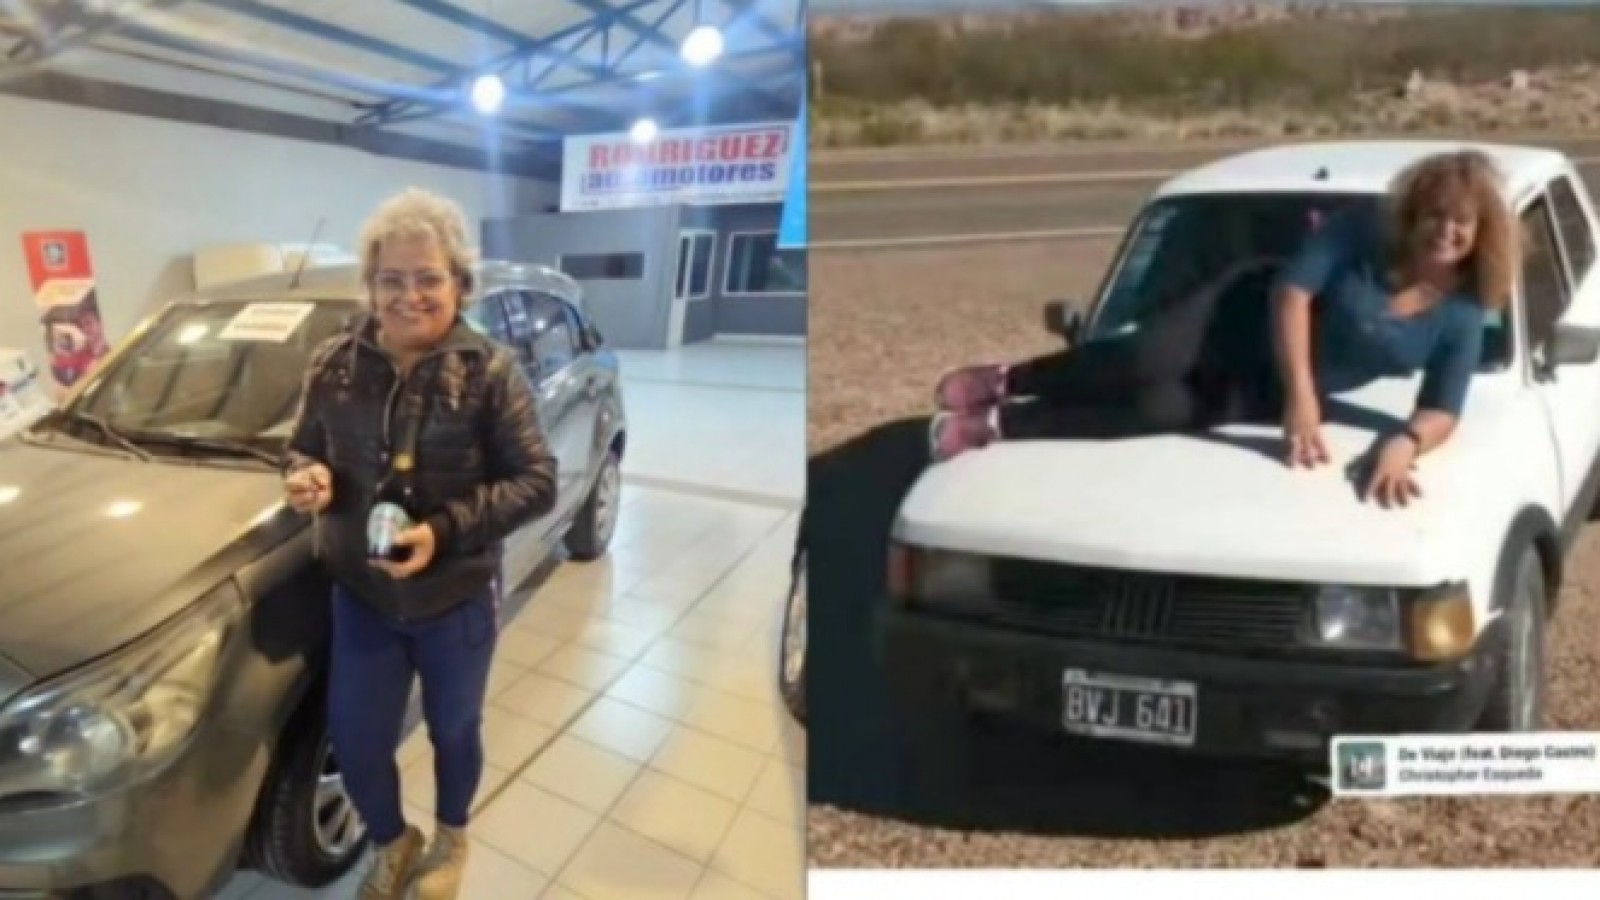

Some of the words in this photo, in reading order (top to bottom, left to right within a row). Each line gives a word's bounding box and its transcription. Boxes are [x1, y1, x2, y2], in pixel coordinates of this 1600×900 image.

[589, 132, 781, 170] RORIGUEZ
[588, 161, 776, 189] aumotores
[1066, 685, 1120, 727] BVJ
[1136, 693, 1188, 732] 641
